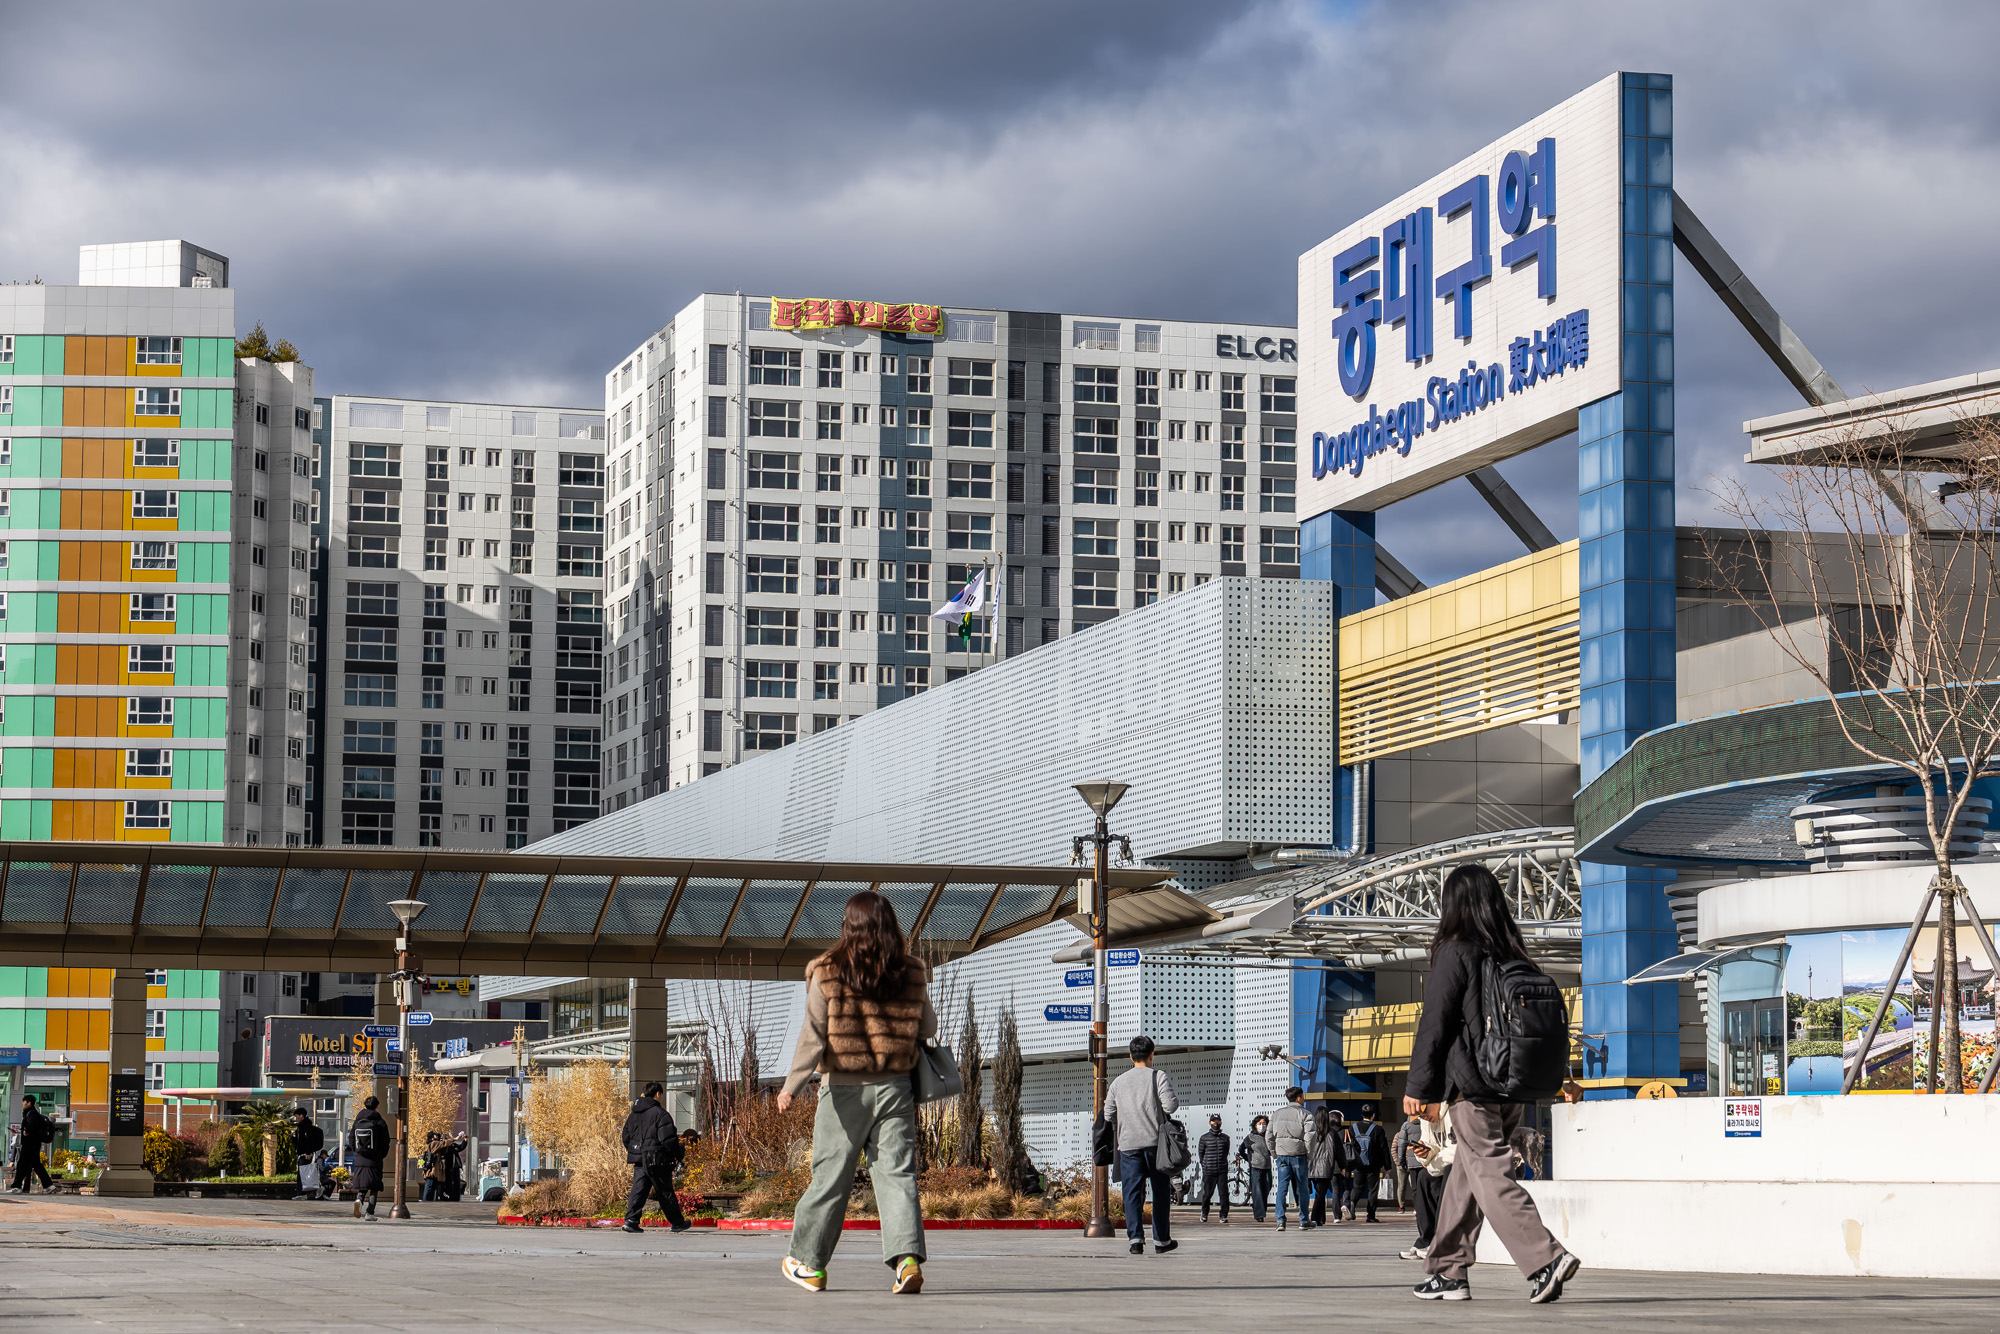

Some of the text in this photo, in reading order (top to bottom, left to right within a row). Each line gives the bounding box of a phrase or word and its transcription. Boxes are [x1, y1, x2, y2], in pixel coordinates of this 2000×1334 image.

[1332, 137, 1557, 397] 동대구역
[1508, 308, 1590, 395] 東大邱驛
[1312, 360, 1505, 480] Dongdaegu Station
[1072, 1006, 1089, 1014] 타는곳
[299, 1033, 346, 1053] Motel
[295, 1055, 325, 1066] 최신시설
[1736, 1104, 1759, 1116] 추락위험
[1745, 1119, 1760, 1127] 마시오
